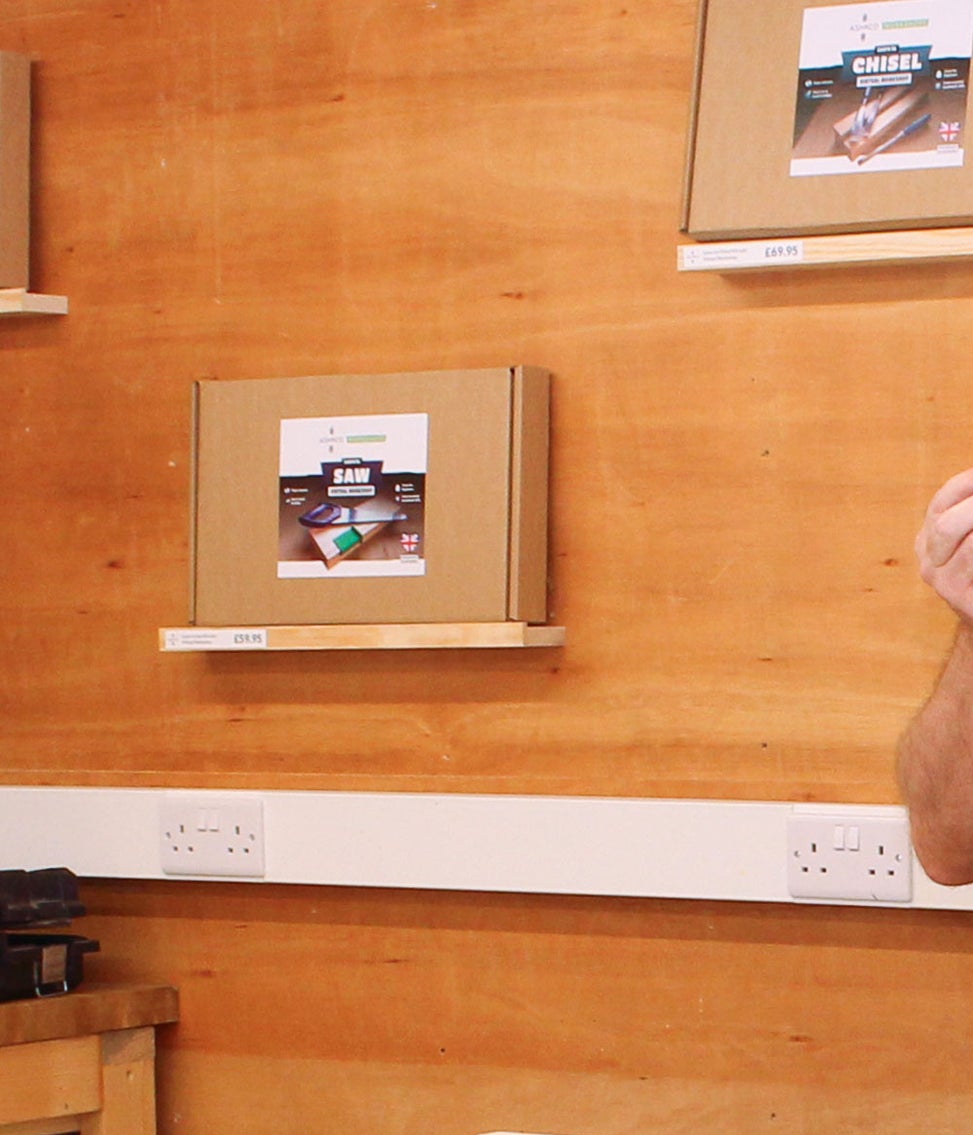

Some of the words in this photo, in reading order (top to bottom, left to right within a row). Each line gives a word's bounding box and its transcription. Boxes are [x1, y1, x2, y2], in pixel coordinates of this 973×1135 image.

[852, 53, 923, 74] CHISEL
[765, 246, 798, 258] £69.95
[333, 467, 371, 484] SAW
